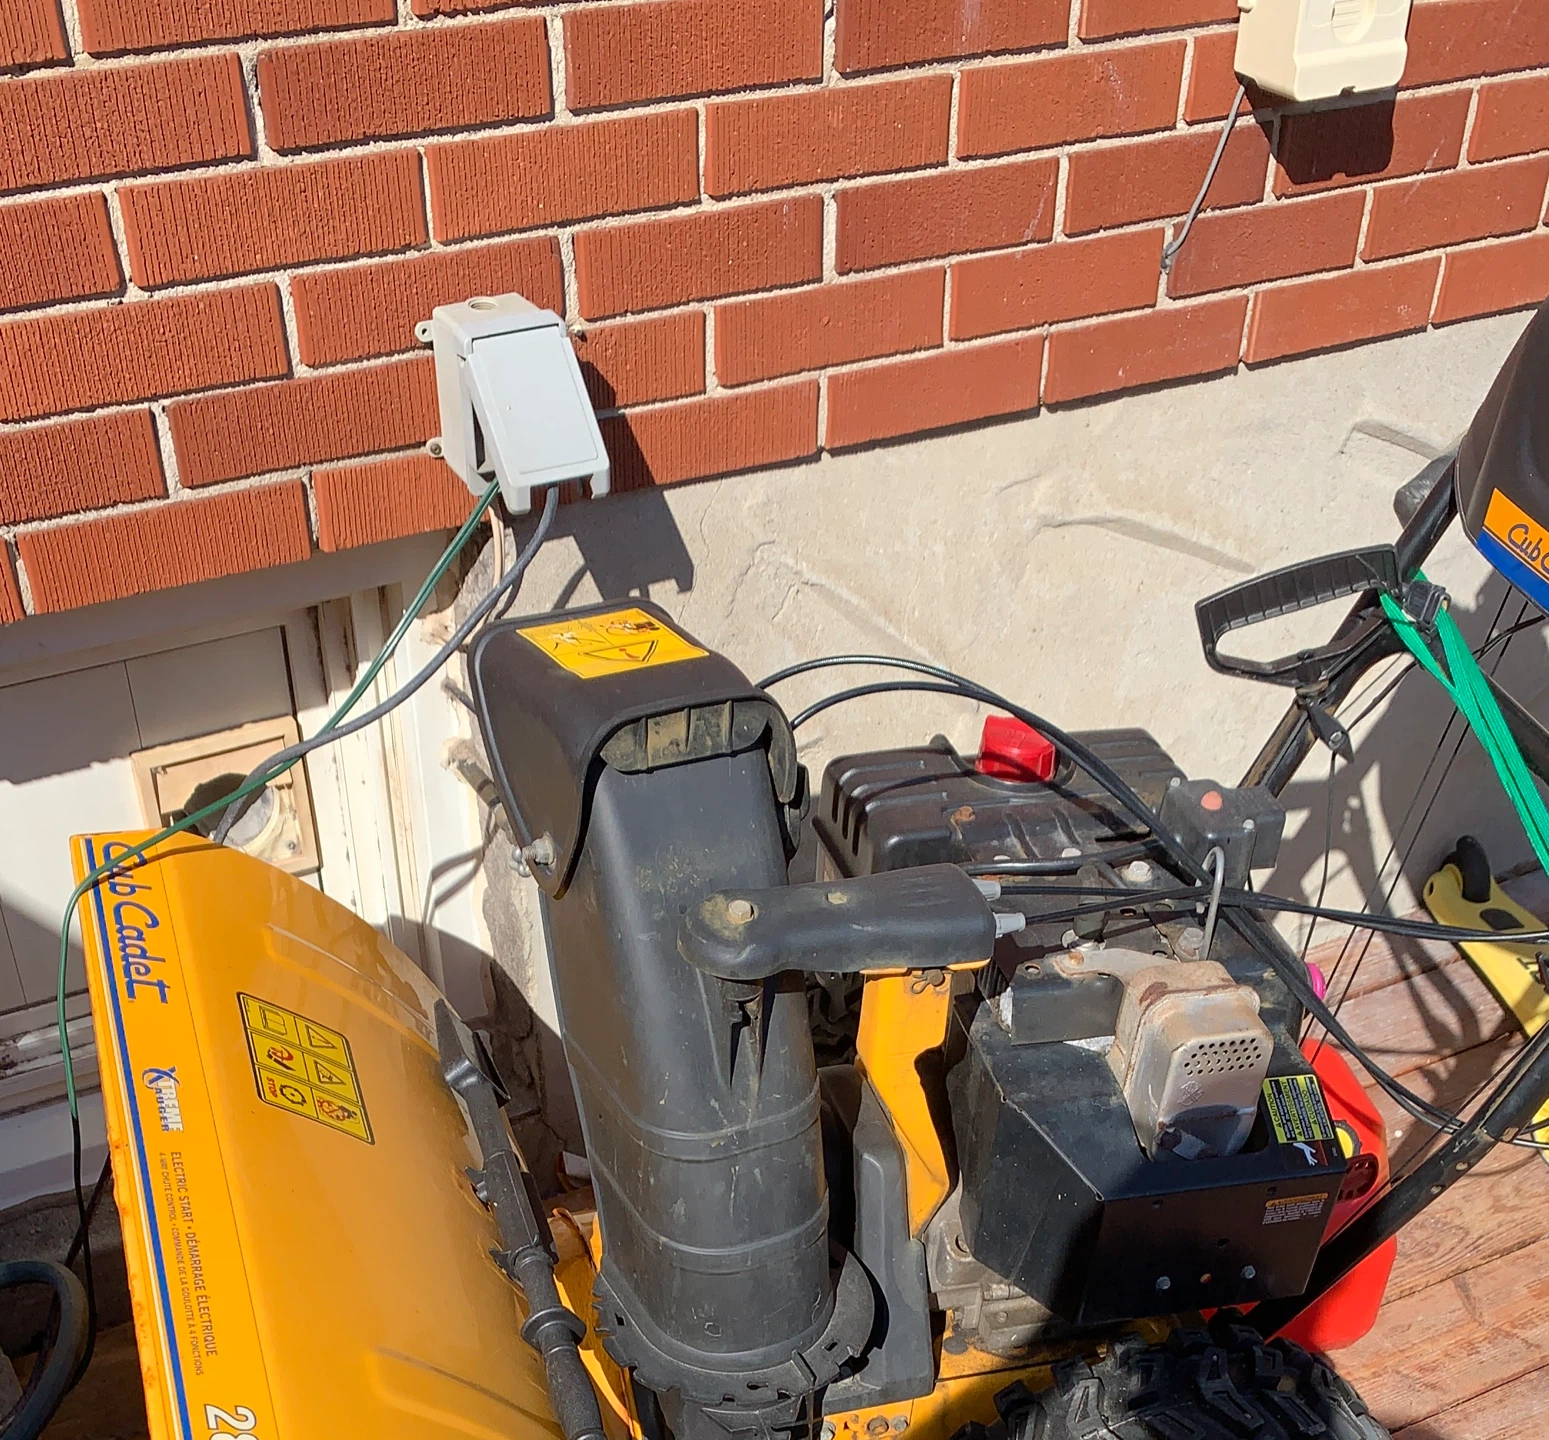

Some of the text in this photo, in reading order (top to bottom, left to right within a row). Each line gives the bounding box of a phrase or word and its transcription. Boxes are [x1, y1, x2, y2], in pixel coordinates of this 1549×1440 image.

[1507, 523, 1543, 562] Cub
[102, 841, 171, 1004] Cub Cadet
[266, 1076, 278, 1098] STOP
[154, 1088, 169, 1132] AUGER
[1267, 1093, 1281, 1122] CAUTION
[1302, 1090, 1316, 1119] CUIDADO
[161, 1171, 172, 1192] CHUTE
[165, 1193, 177, 1222] CONTROL
[171, 1228, 185, 1265] COMMANDE
[171, 1151, 218, 1357] ELECTRIC START DÉMARRAGE ÉLECTRIQUE
[178, 1266, 187, 1275] DE
[180, 1277, 188, 1285] LA
[182, 1286, 195, 1322] GOULOTTE
[190, 1336, 204, 1376] FONCTIONS
